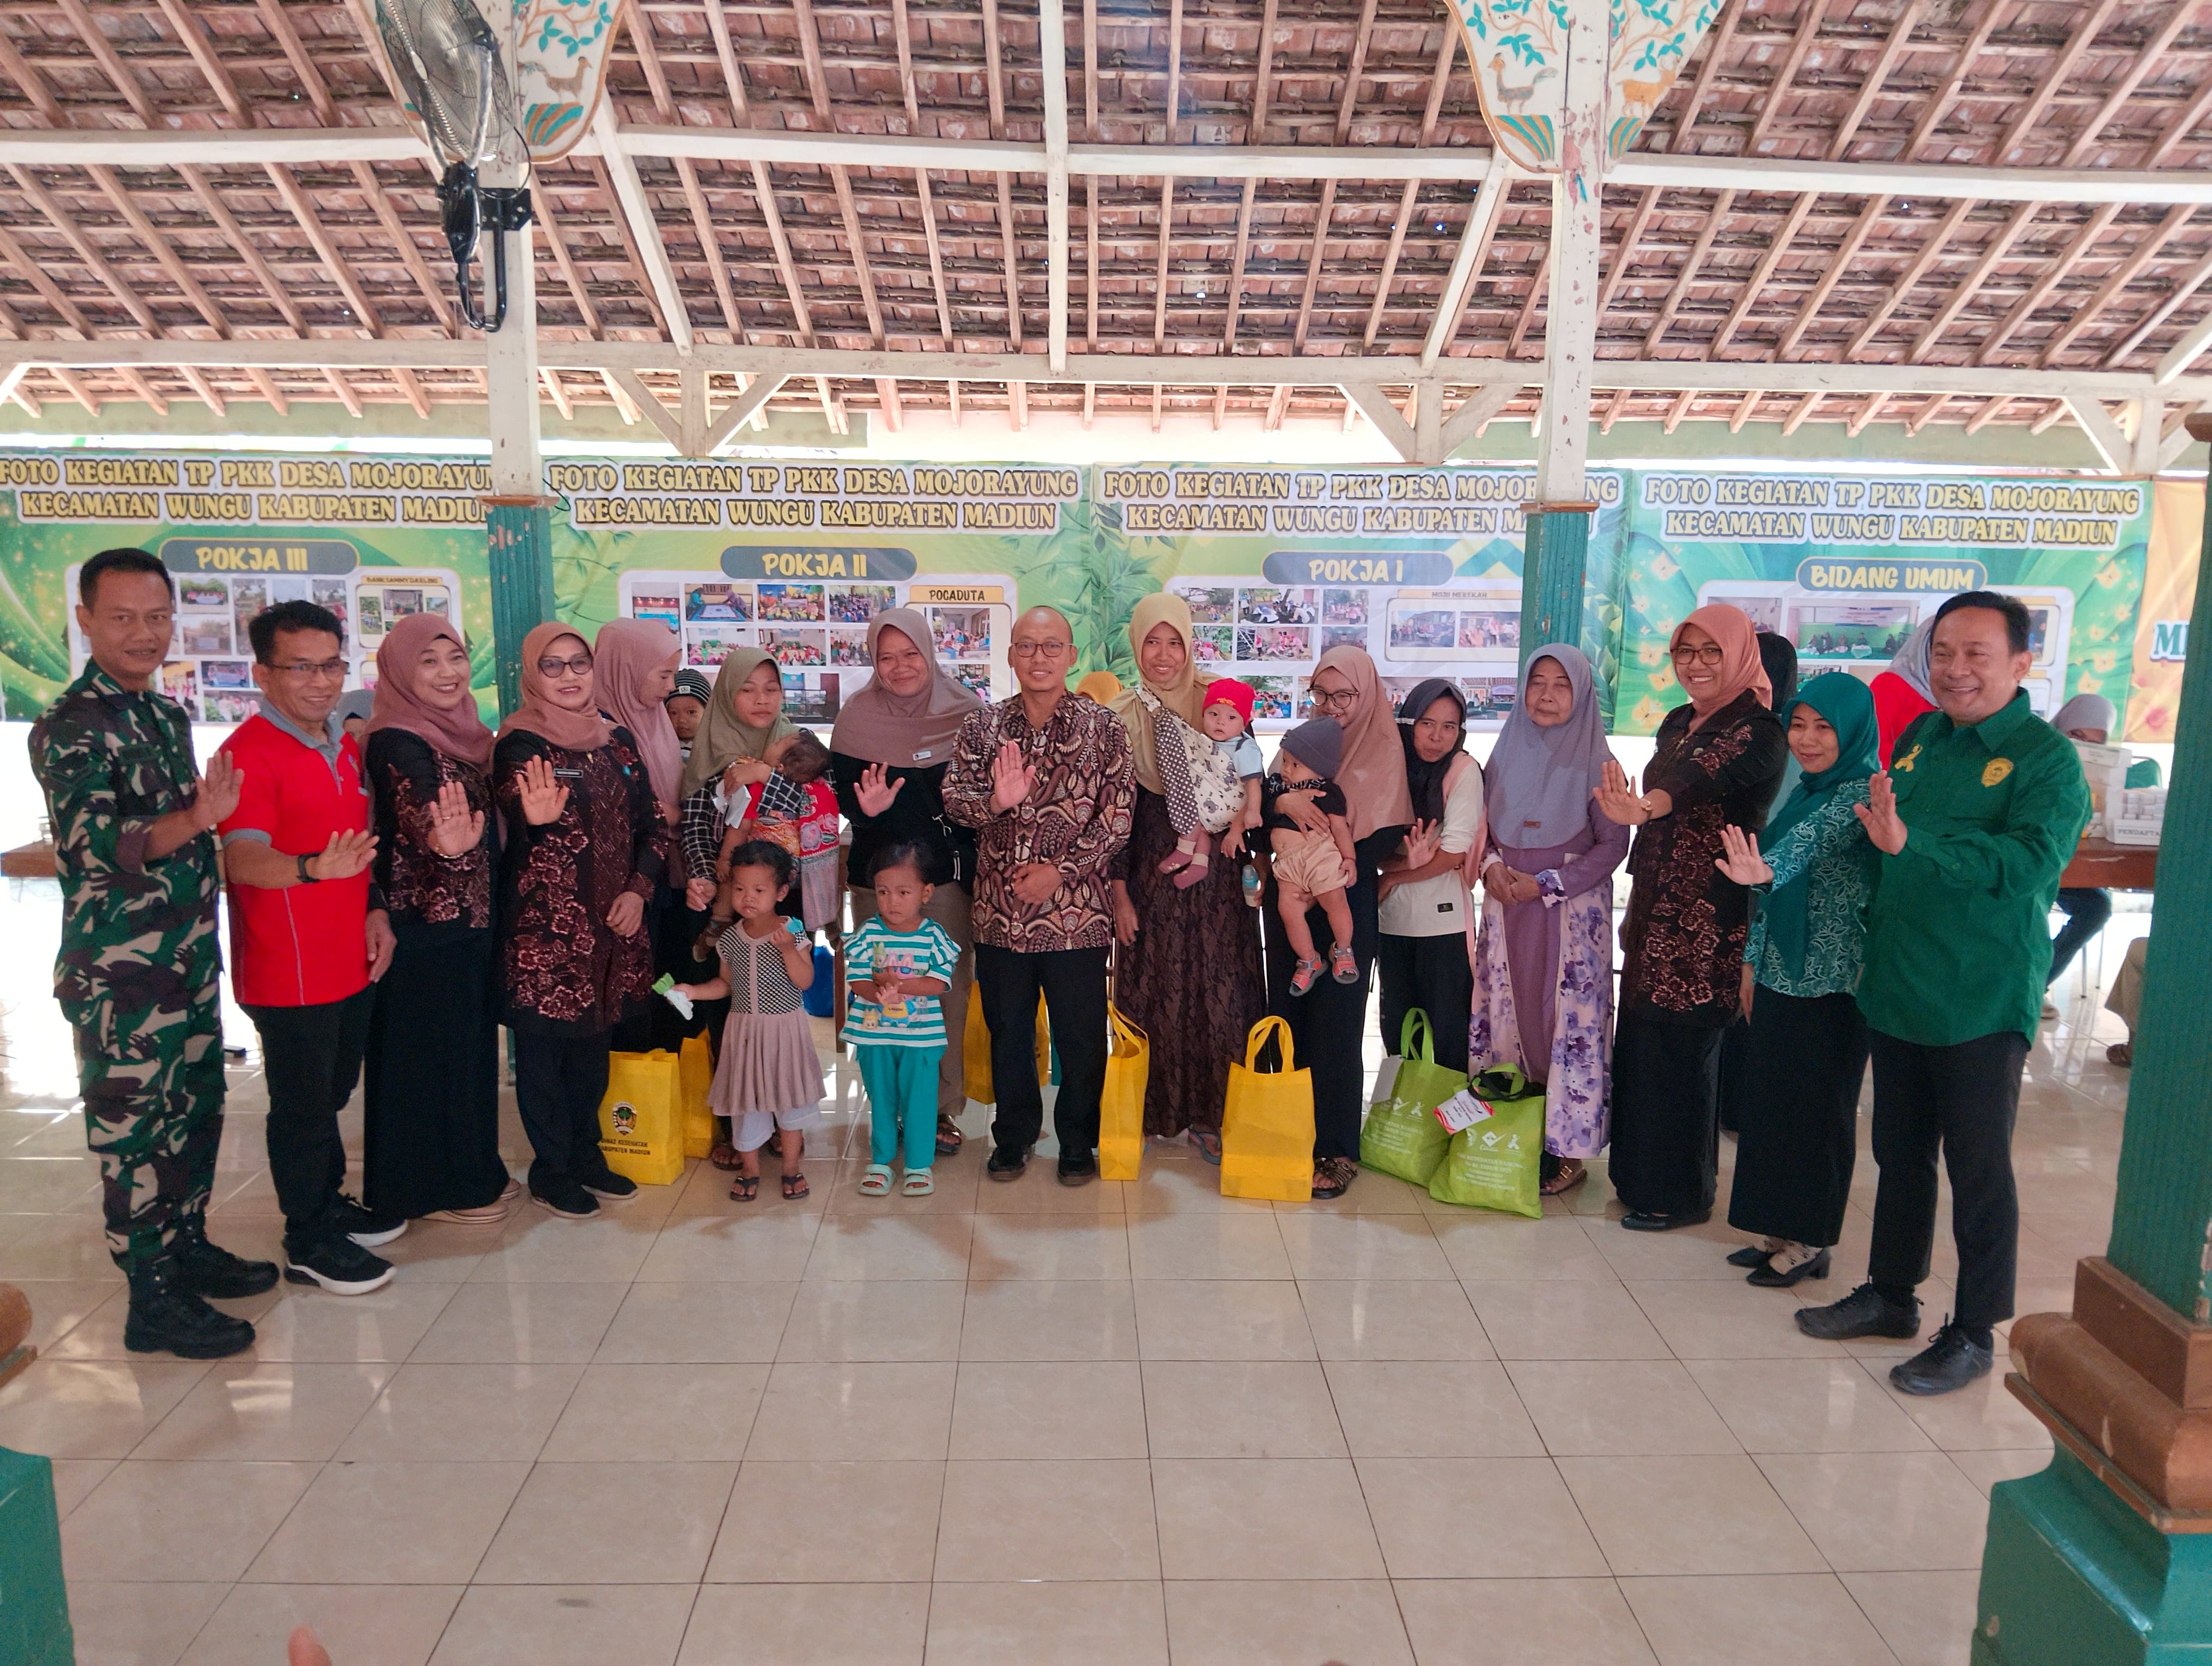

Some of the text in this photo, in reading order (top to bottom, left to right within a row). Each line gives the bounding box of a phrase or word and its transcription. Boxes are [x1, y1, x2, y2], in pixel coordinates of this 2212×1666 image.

[0, 459, 59, 485] FOTO
[65, 459, 178, 485] KEGIATAN
[185, 460, 215, 485] TP
[221, 460, 275, 486] PKK
[280, 462, 346, 488] DESA
[550, 464, 1077, 496] FOTO KEGIATAN TP PKK DESA MOJORAYUNG
[1104, 471, 1618, 502] FOTO KEGIATAN TP PKK DESA MOJORNG
[21, 491, 159, 518] KECAMATAN
[165, 492, 252, 519] WUNGU
[258, 494, 395, 521] KABUPATEN
[1645, 478, 2139, 514] FOTO KEGIATAN TP PKK DESA MOJORAYUNG
[575, 497, 1055, 529] KECAMATAN WUNGU KABUPATEN MADIUN
[1127, 504, 1266, 531] KECAMATAN
[1274, 505, 1358, 532] WUNGU
[1363, 507, 1496, 533] KABUPATEN
[1666, 510, 2117, 544] KECAMATAN WUNGU KABUPATEN MADIUN
[196, 547, 308, 571] POKJA III
[762, 553, 866, 577] POKJA II
[1309, 559, 1403, 582] POKJA I
[1811, 565, 1975, 590] BIDANG UMUM
[929, 589, 985, 601] POCADUTA
